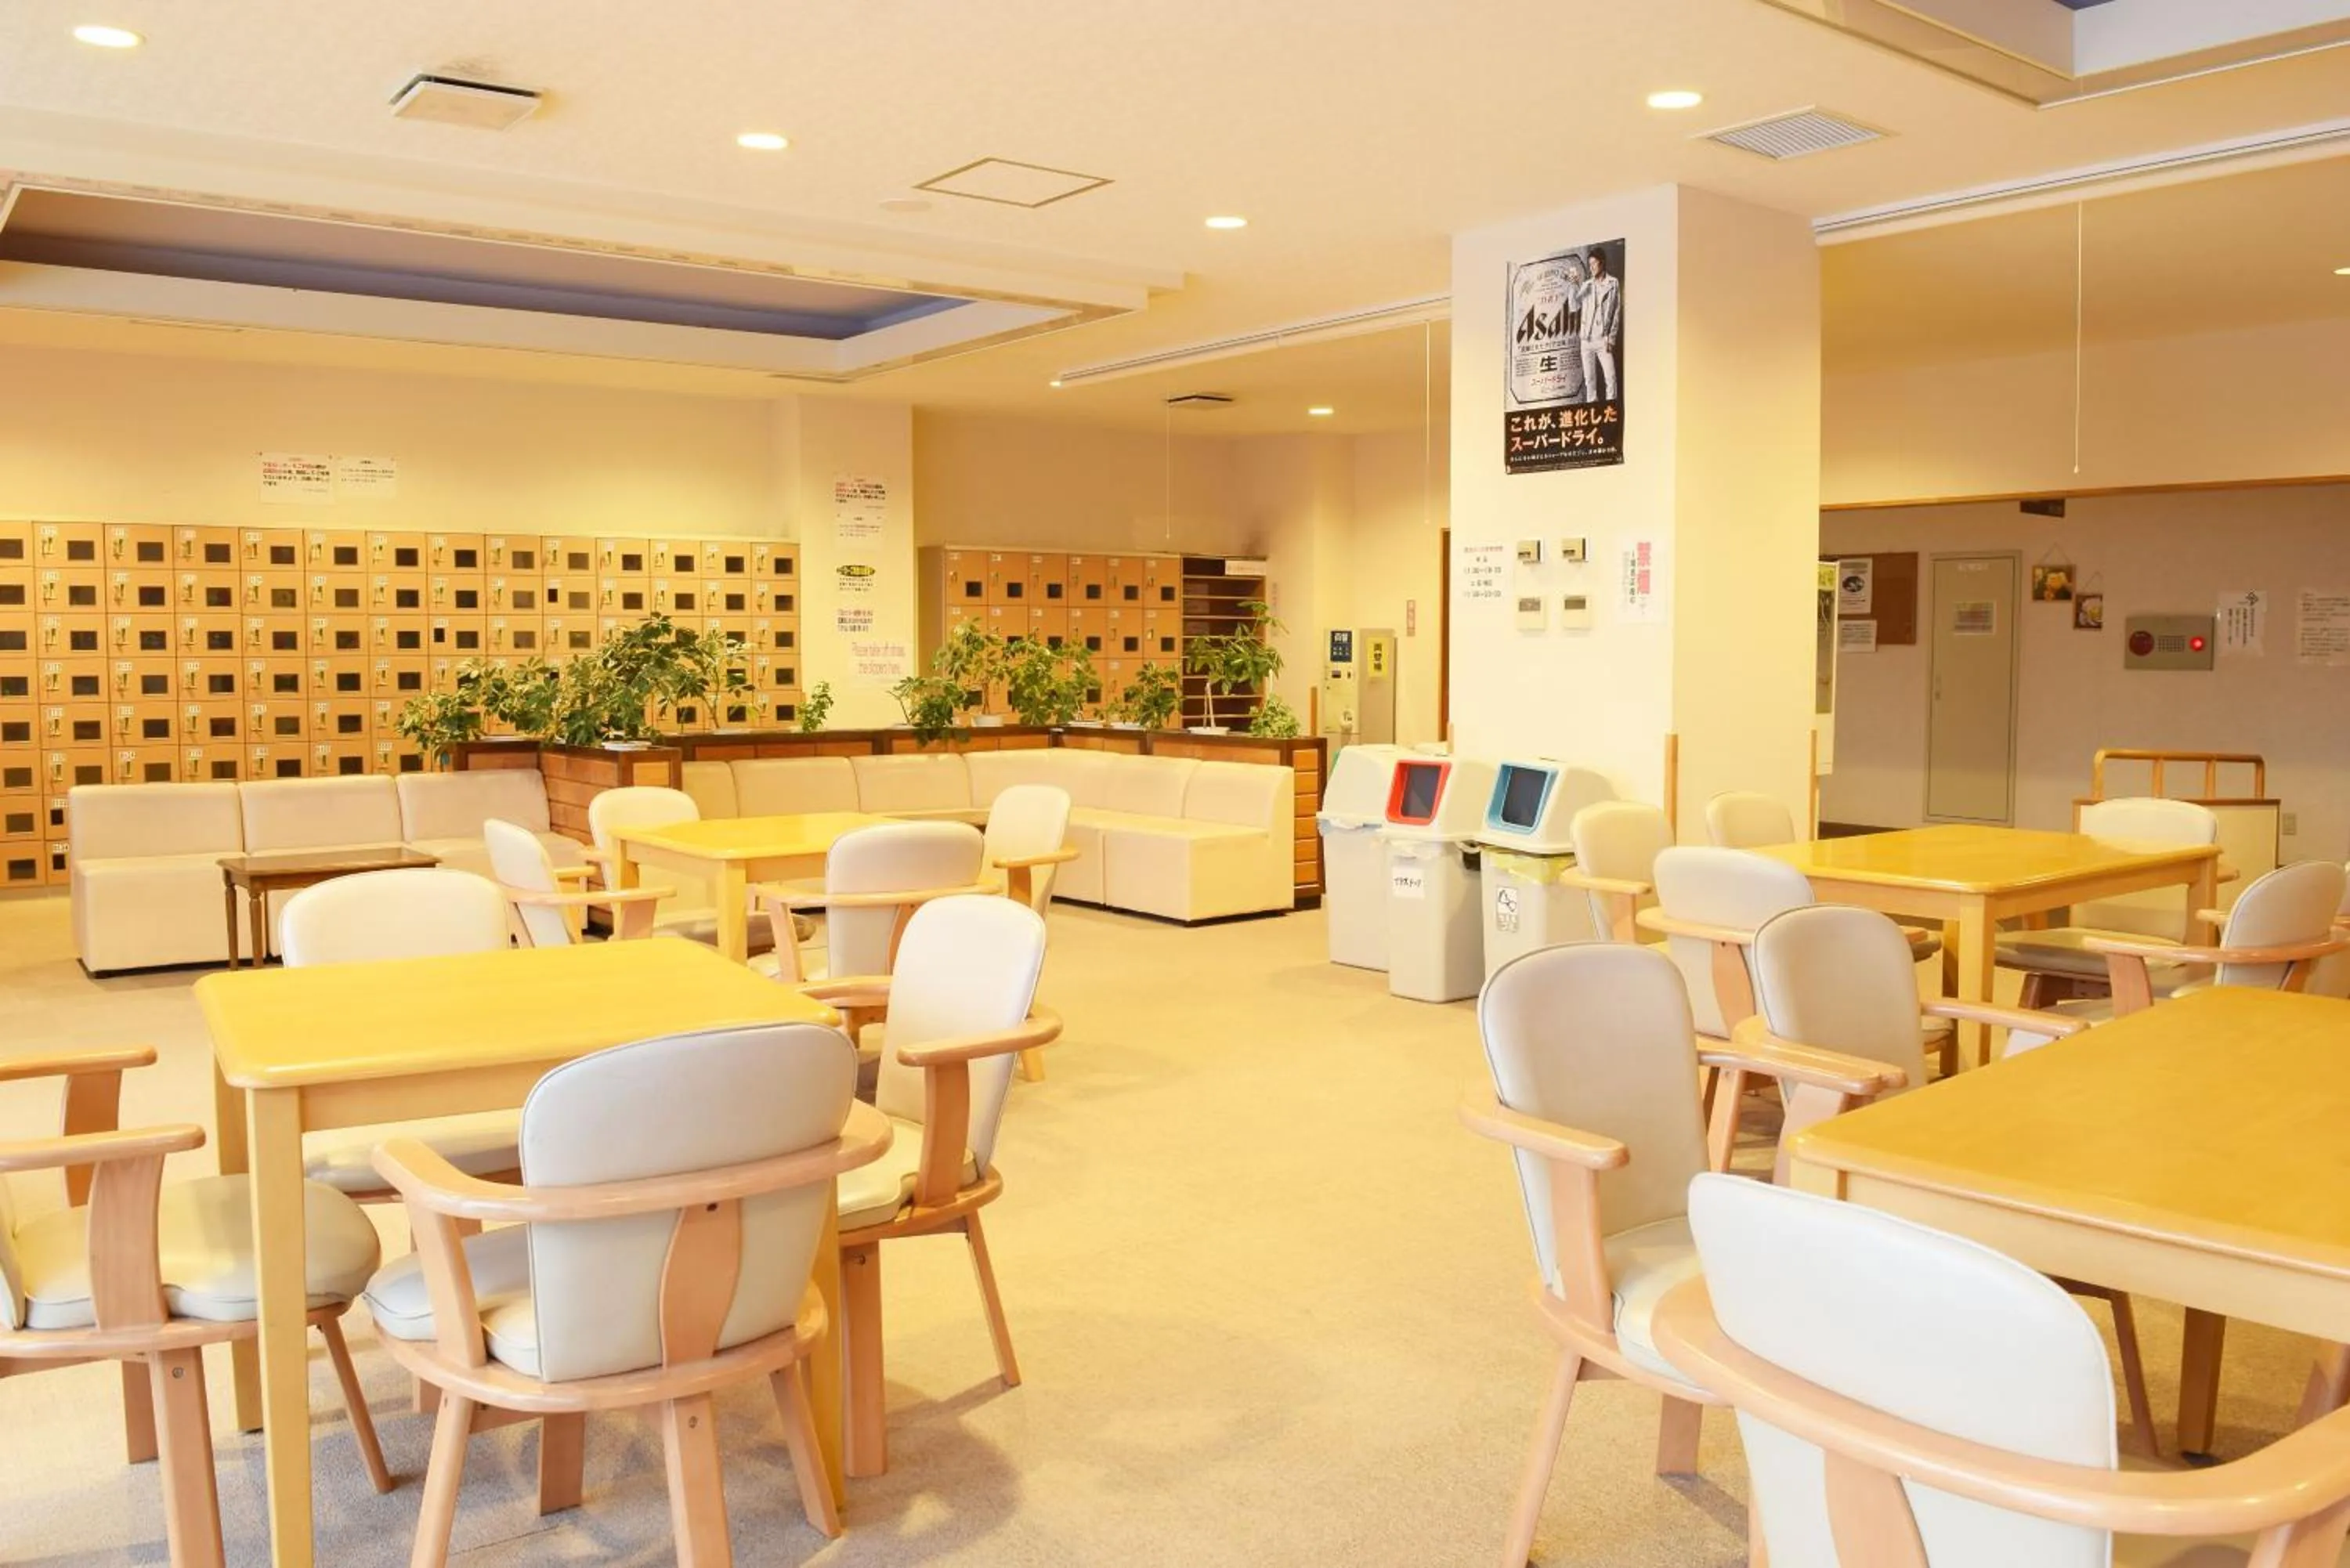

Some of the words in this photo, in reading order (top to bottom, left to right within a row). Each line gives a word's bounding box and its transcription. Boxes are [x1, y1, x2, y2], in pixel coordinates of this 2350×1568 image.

[1517, 297, 1582, 344] Asahi
[1539, 356, 1558, 373] 生
[1511, 405, 1618, 432] これが、進化した
[1510, 428, 1603, 452] スーパードライ。
